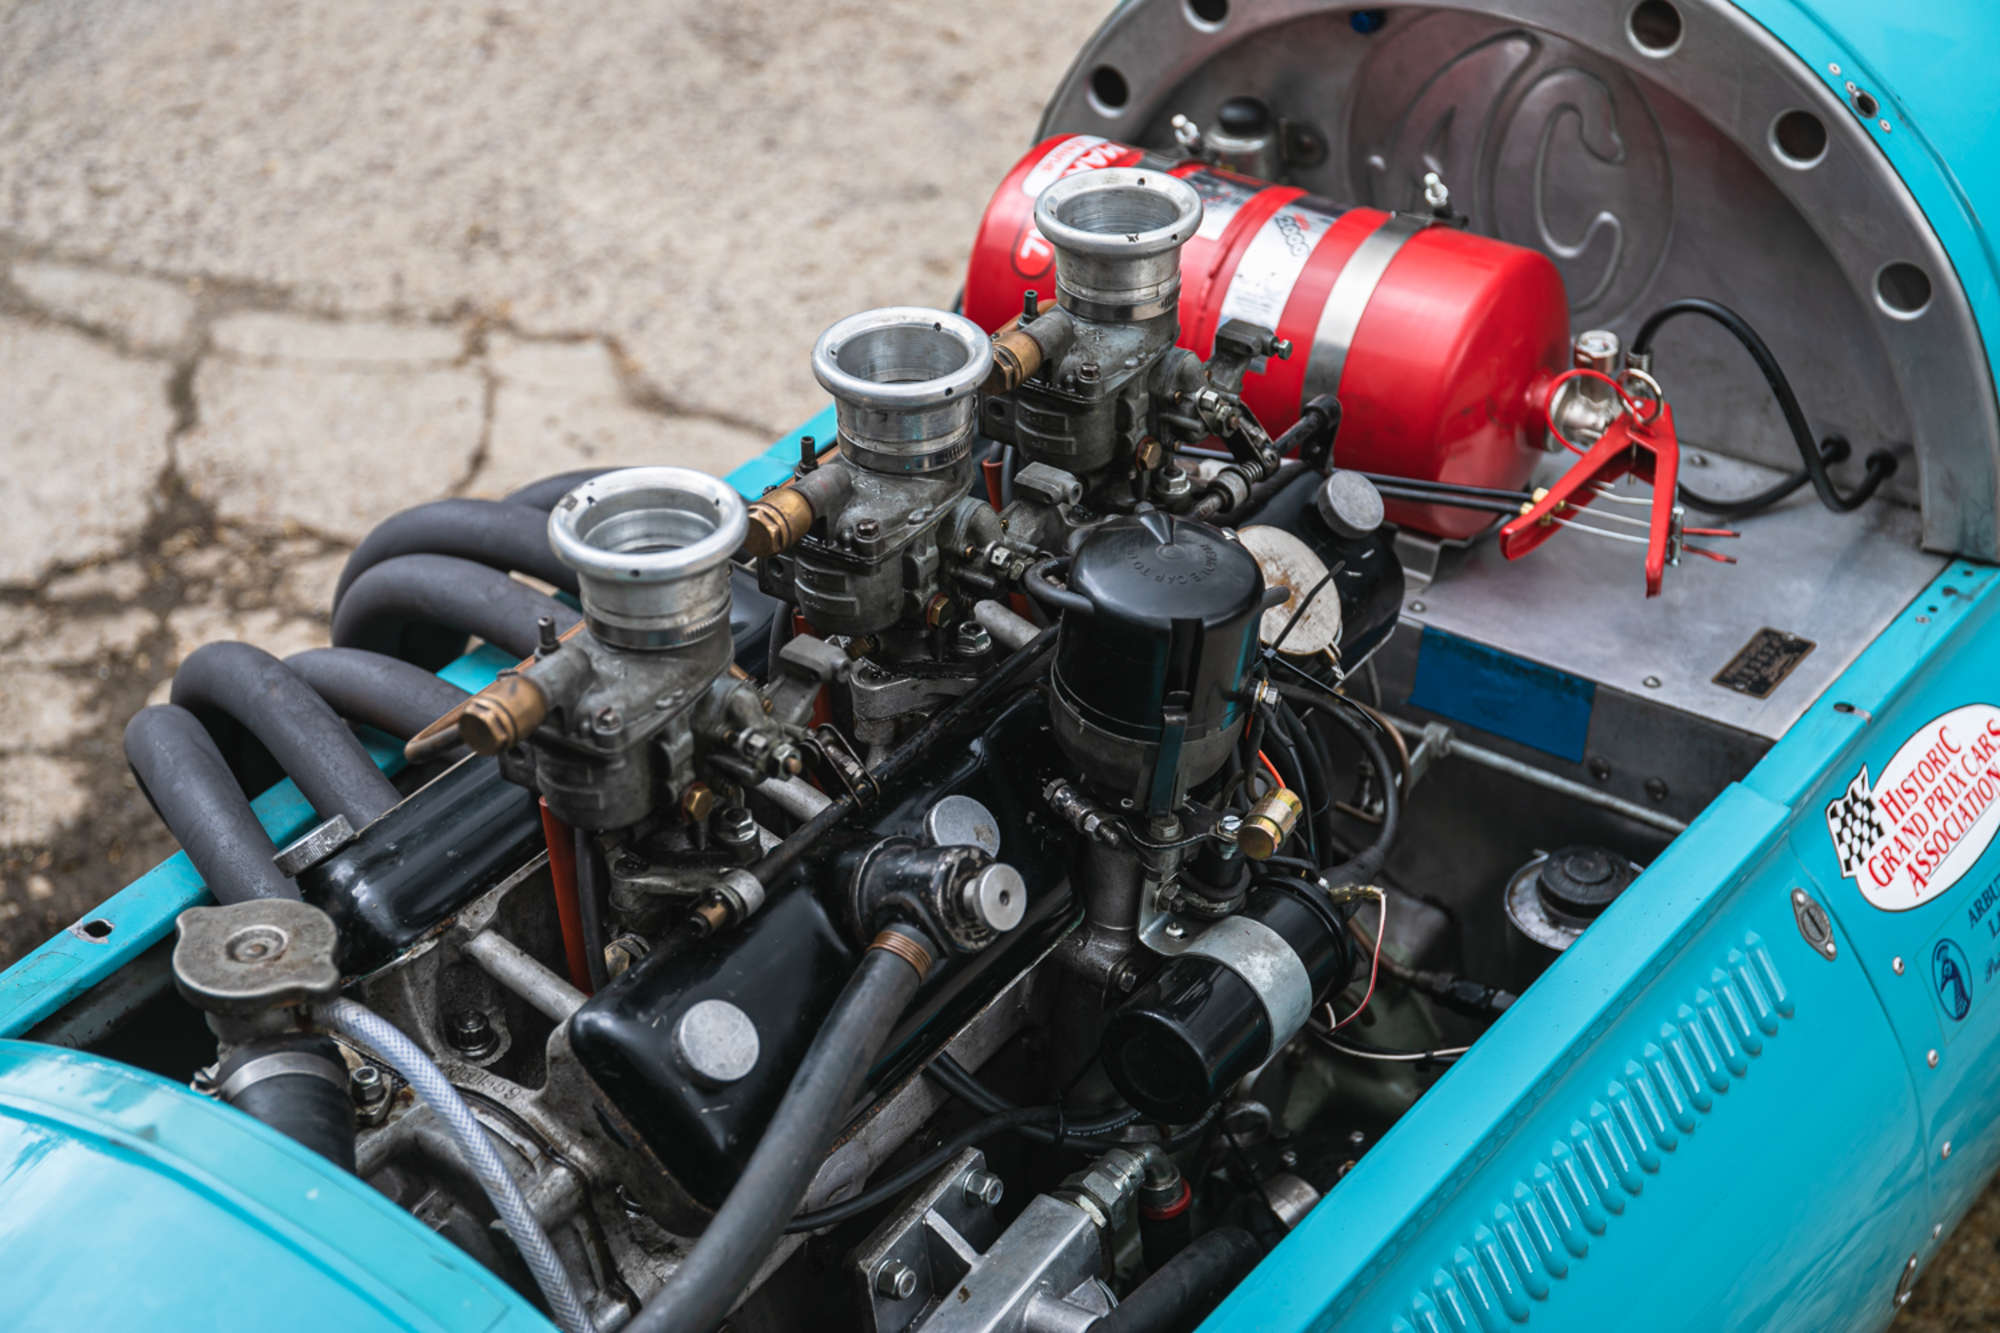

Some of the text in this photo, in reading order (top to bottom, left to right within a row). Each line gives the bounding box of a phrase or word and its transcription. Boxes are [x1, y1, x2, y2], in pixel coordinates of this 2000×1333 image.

[1868, 717, 2000, 888] GRAND PRIX CARS
[1878, 724, 1962, 825] HISTORIC
